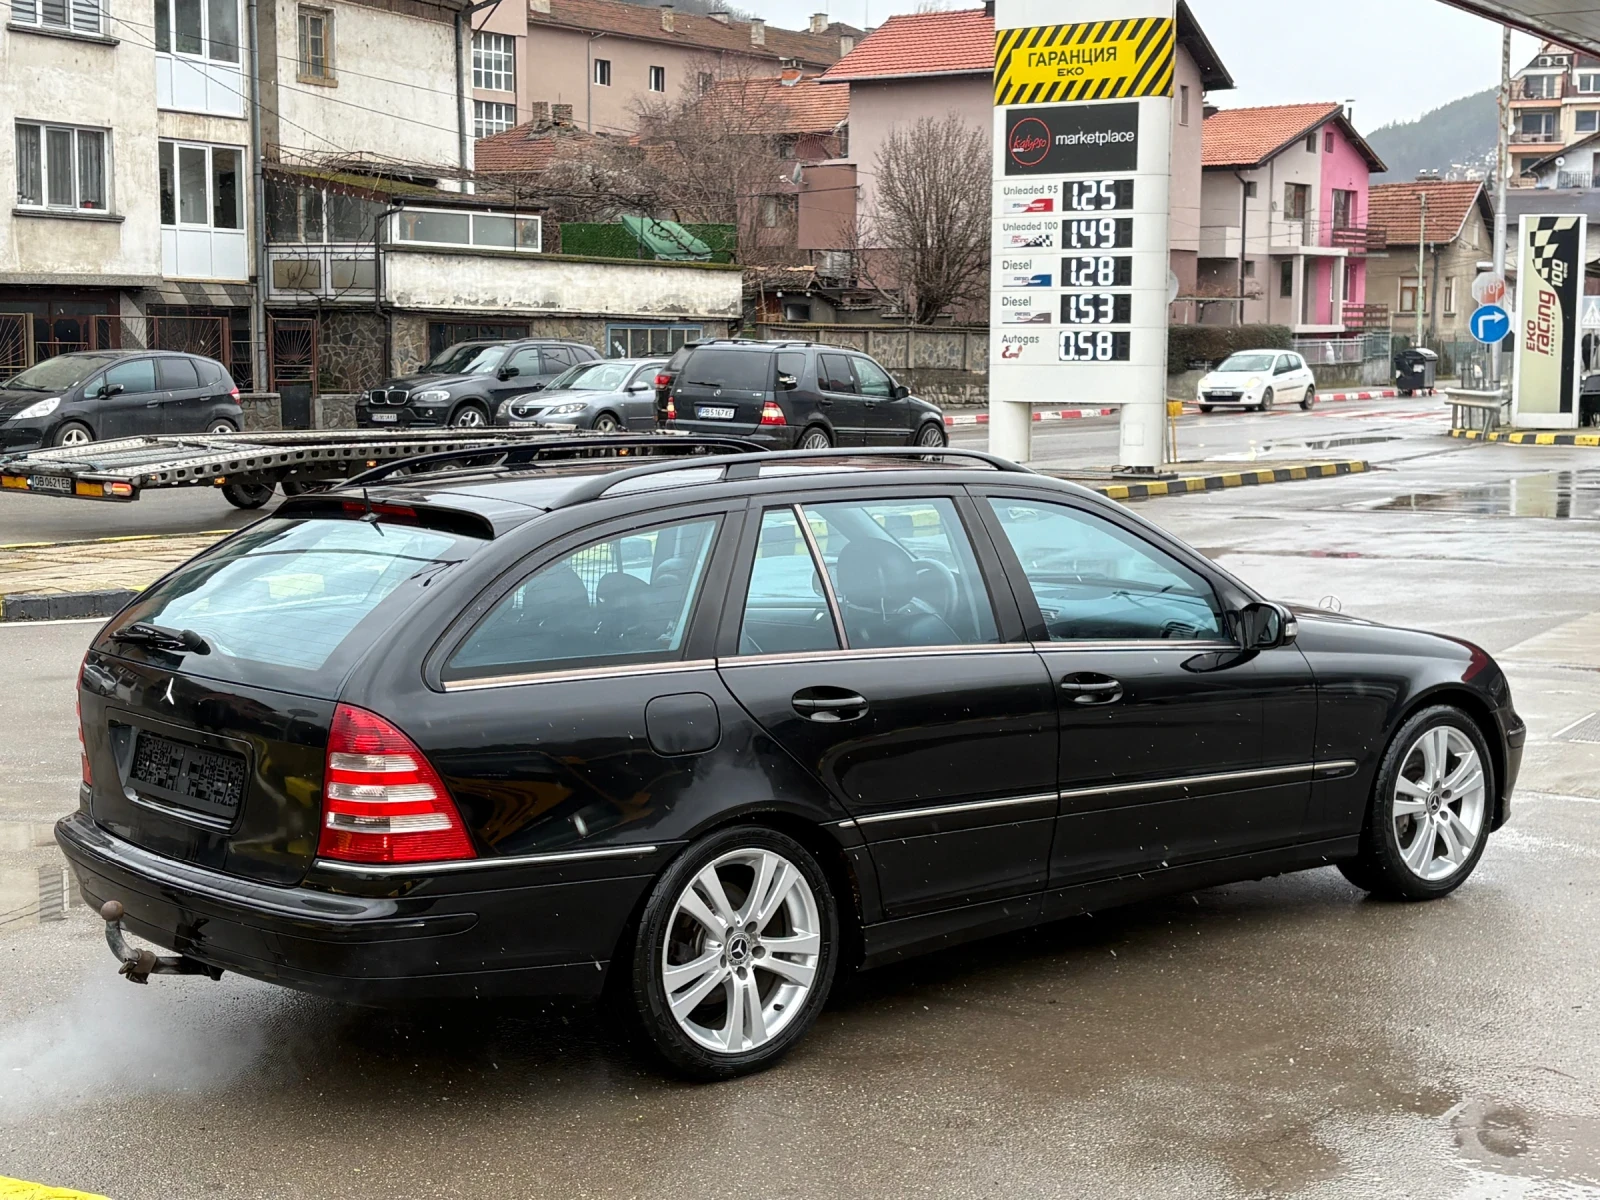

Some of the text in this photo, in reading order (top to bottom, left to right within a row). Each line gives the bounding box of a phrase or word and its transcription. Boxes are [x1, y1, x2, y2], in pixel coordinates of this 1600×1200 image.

[1028, 46, 1117, 68] ГАРАНЦИЯ
[1055, 129, 1135, 146] marketplace
[1003, 184, 1059, 196] Unleaded 95
[1072, 180, 1116, 211] 1.25
[1003, 221, 1059, 231] Unleaded 100
[1071, 218, 1116, 249] 1.49
[1002, 260, 1032, 270] Diesel
[1070, 256, 1115, 286] 1.28
[1551, 259, 1563, 287] 100
[1002, 296, 1032, 306] Diesel
[1070, 294, 1114, 323] 1.53
[1526, 320, 1536, 351] EKO
[1536, 289, 1556, 355] racing
[1001, 334, 1040, 346] Autogas
[1060, 331, 1113, 360] 0.58
